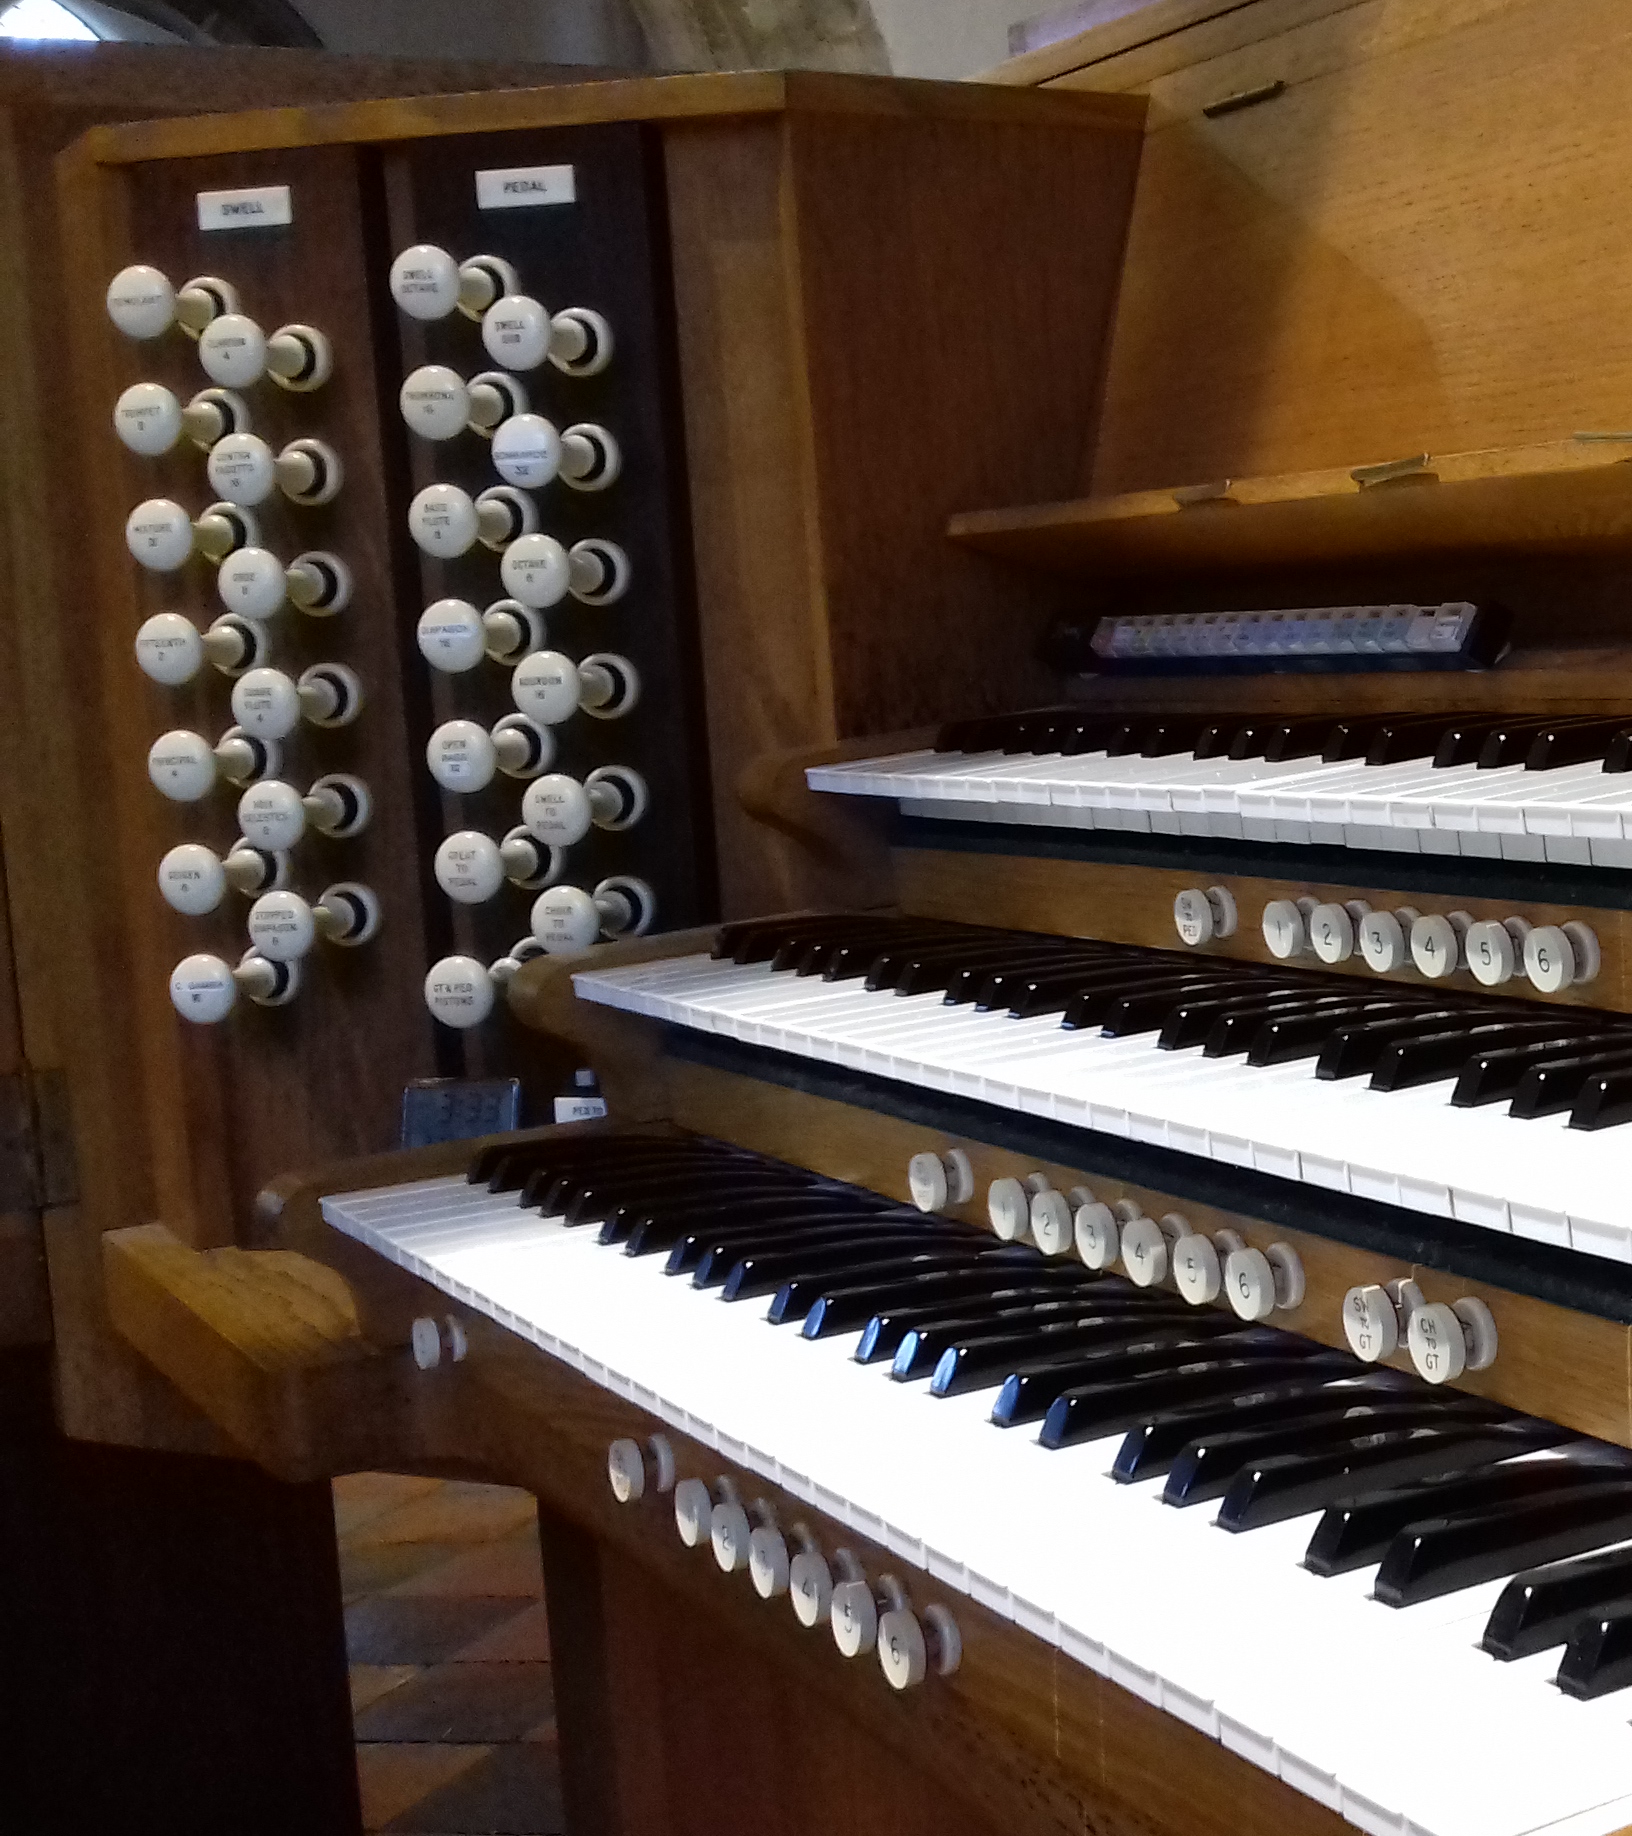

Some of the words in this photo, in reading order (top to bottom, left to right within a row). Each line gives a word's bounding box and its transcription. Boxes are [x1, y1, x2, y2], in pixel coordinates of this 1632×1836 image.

[1322, 923, 1333, 946] 2
[1372, 931, 1383, 954] 3
[1424, 935, 1435, 959] 4
[1480, 941, 1491, 966] 5
[1537, 948, 1550, 973] 6
[1041, 1212, 1052, 1236] 2
[1087, 1224, 1097, 1249] 3
[1134, 1241, 1145, 1265] 4
[1186, 1257, 1197, 1284] 5
[1238, 1271, 1250, 1299] 6
[1420, 1317, 1437, 1335] CH
[1359, 1334, 1372, 1351] GT
[1425, 1337, 1437, 1350] TO
[1426, 1354, 1439, 1371] GT
[721, 1525, 732, 1551] 2
[891, 1635, 901, 1667] 6
